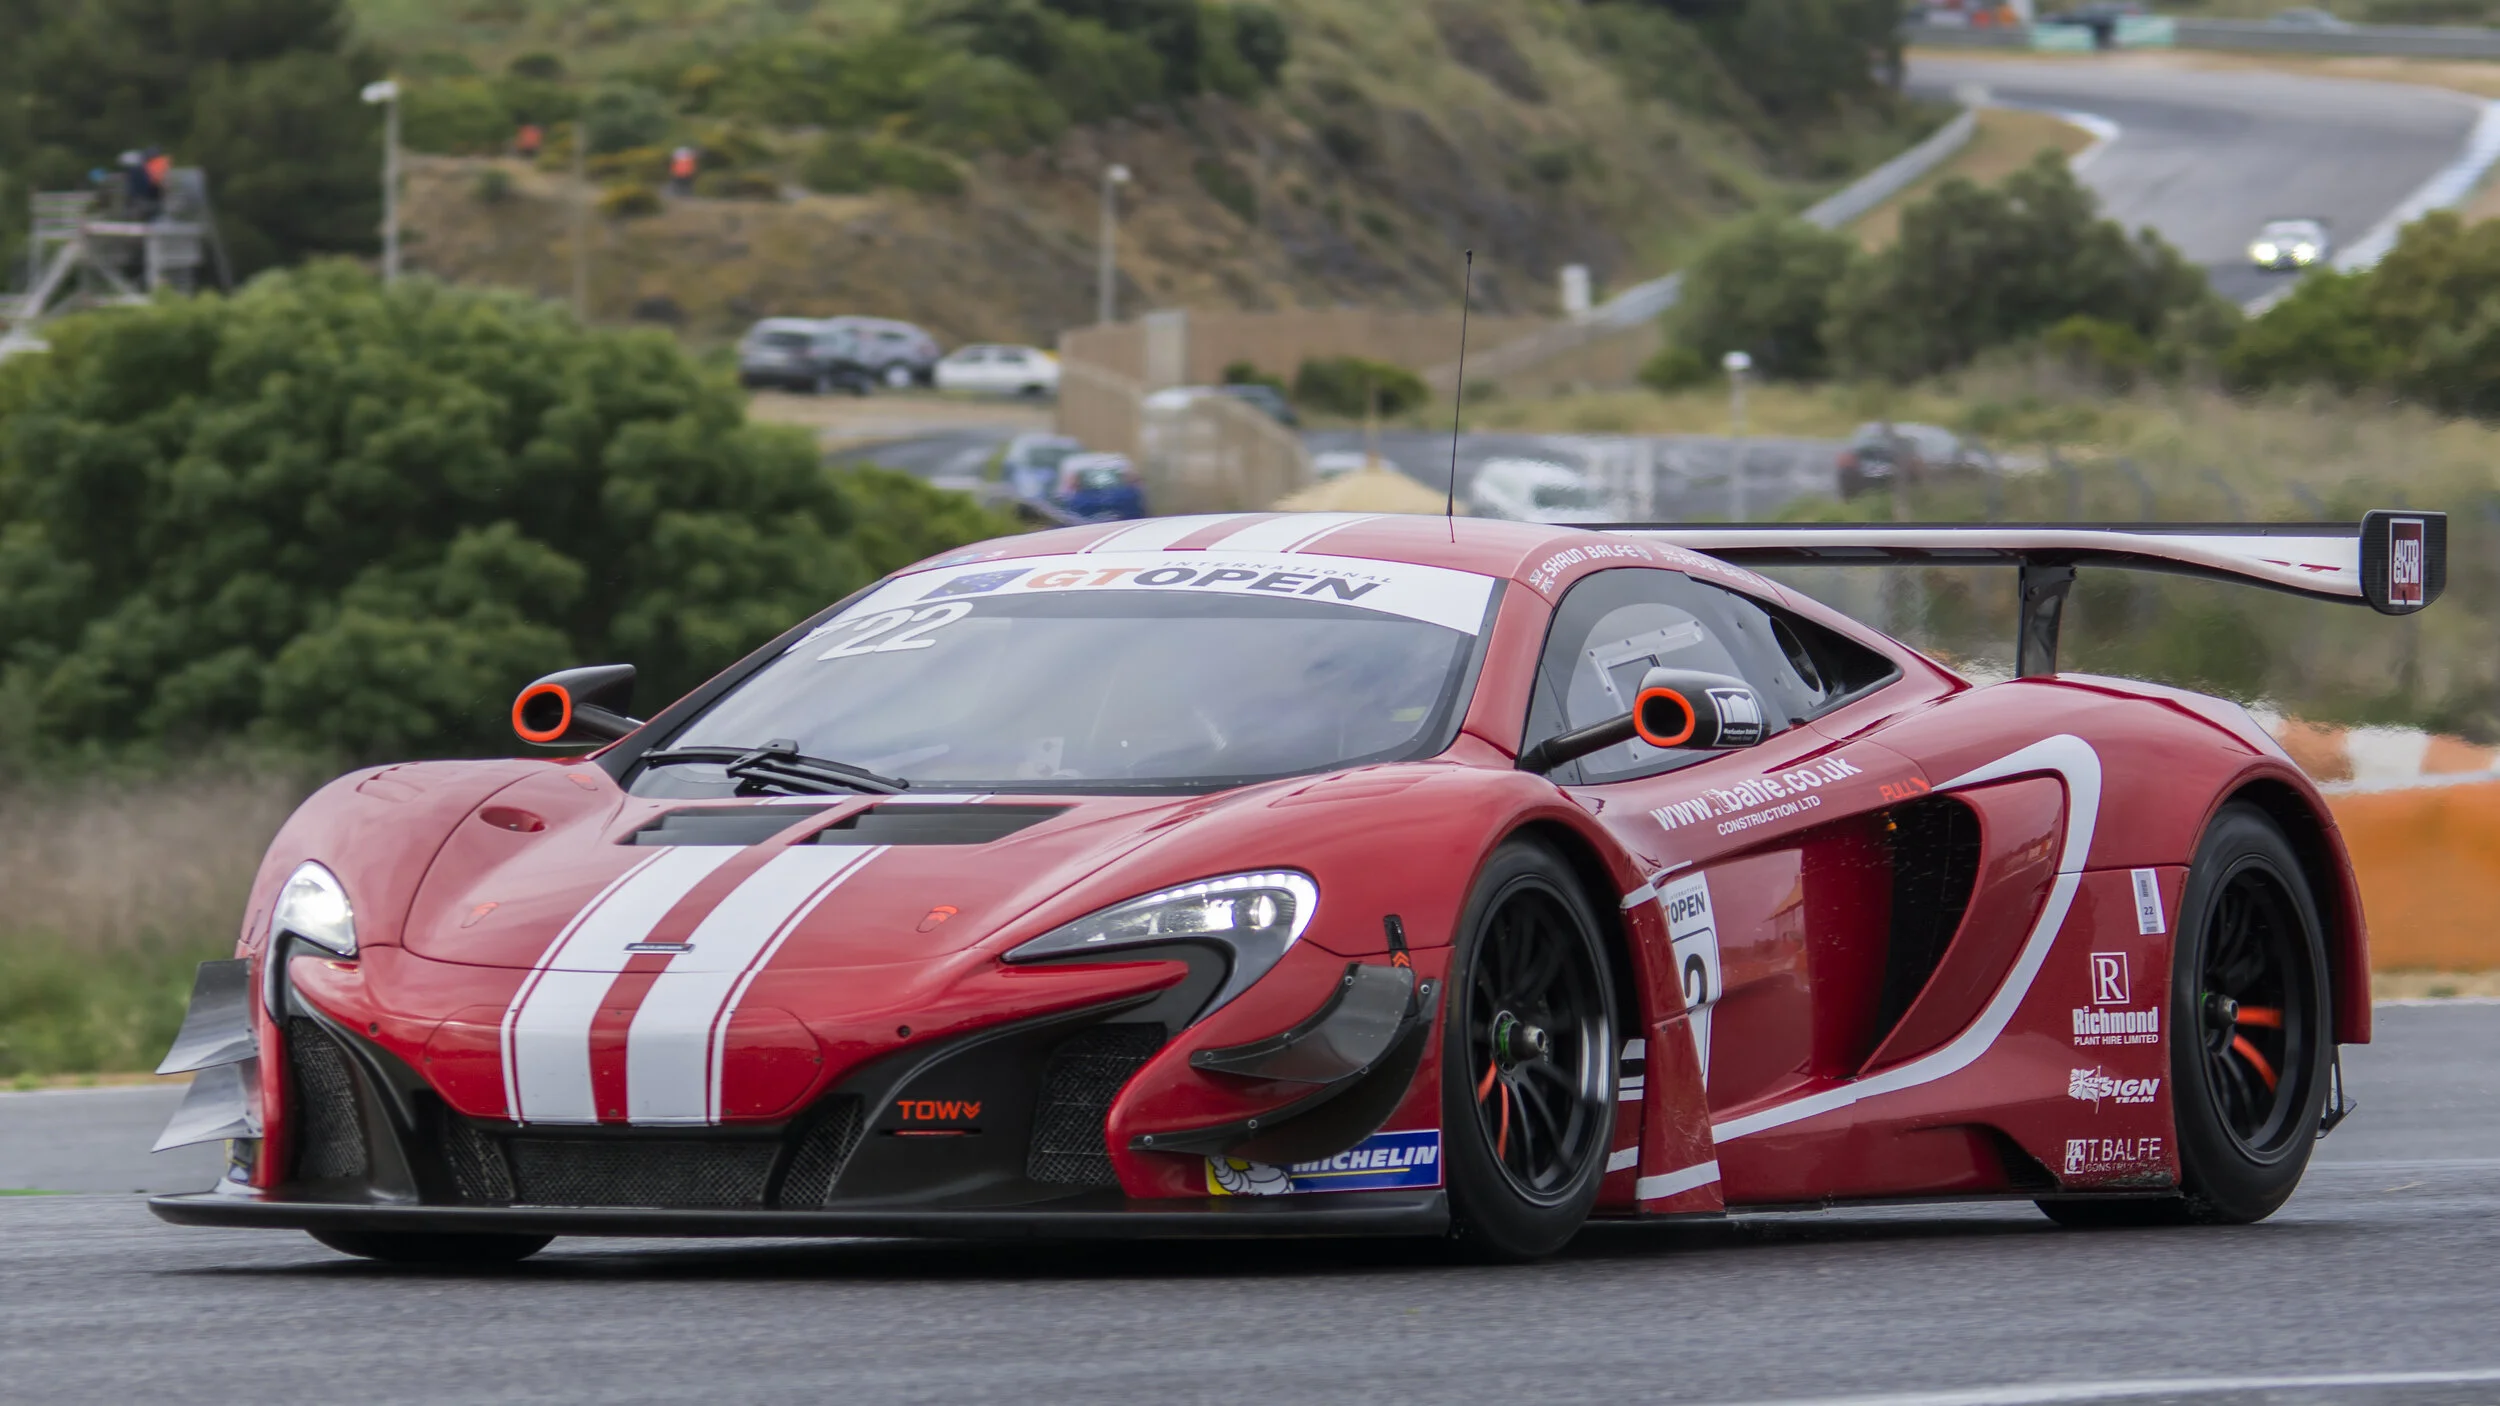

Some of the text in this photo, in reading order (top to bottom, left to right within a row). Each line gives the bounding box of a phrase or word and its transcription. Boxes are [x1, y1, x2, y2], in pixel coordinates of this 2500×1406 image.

[1541, 544, 1639, 578] SHAUN BALFE
[2394, 539, 2420, 562] AUTO
[1162, 561, 1392, 584] INTERNATIONAL
[2393, 560, 2420, 584] GLYM
[1879, 779, 1917, 801] PULL
[1716, 794, 1821, 836] CONSTRUCTION LTD
[2143, 906, 2155, 915] 22
[2096, 958, 2126, 1000] R
[2072, 1006, 2159, 1035] Richmond
[2073, 1034, 2159, 1046] PLANT HIRE LIMITED
[2099, 1078, 2161, 1098] SIGN
[896, 1100, 962, 1120] TOW
[2115, 1096, 2155, 1104] TEAM
